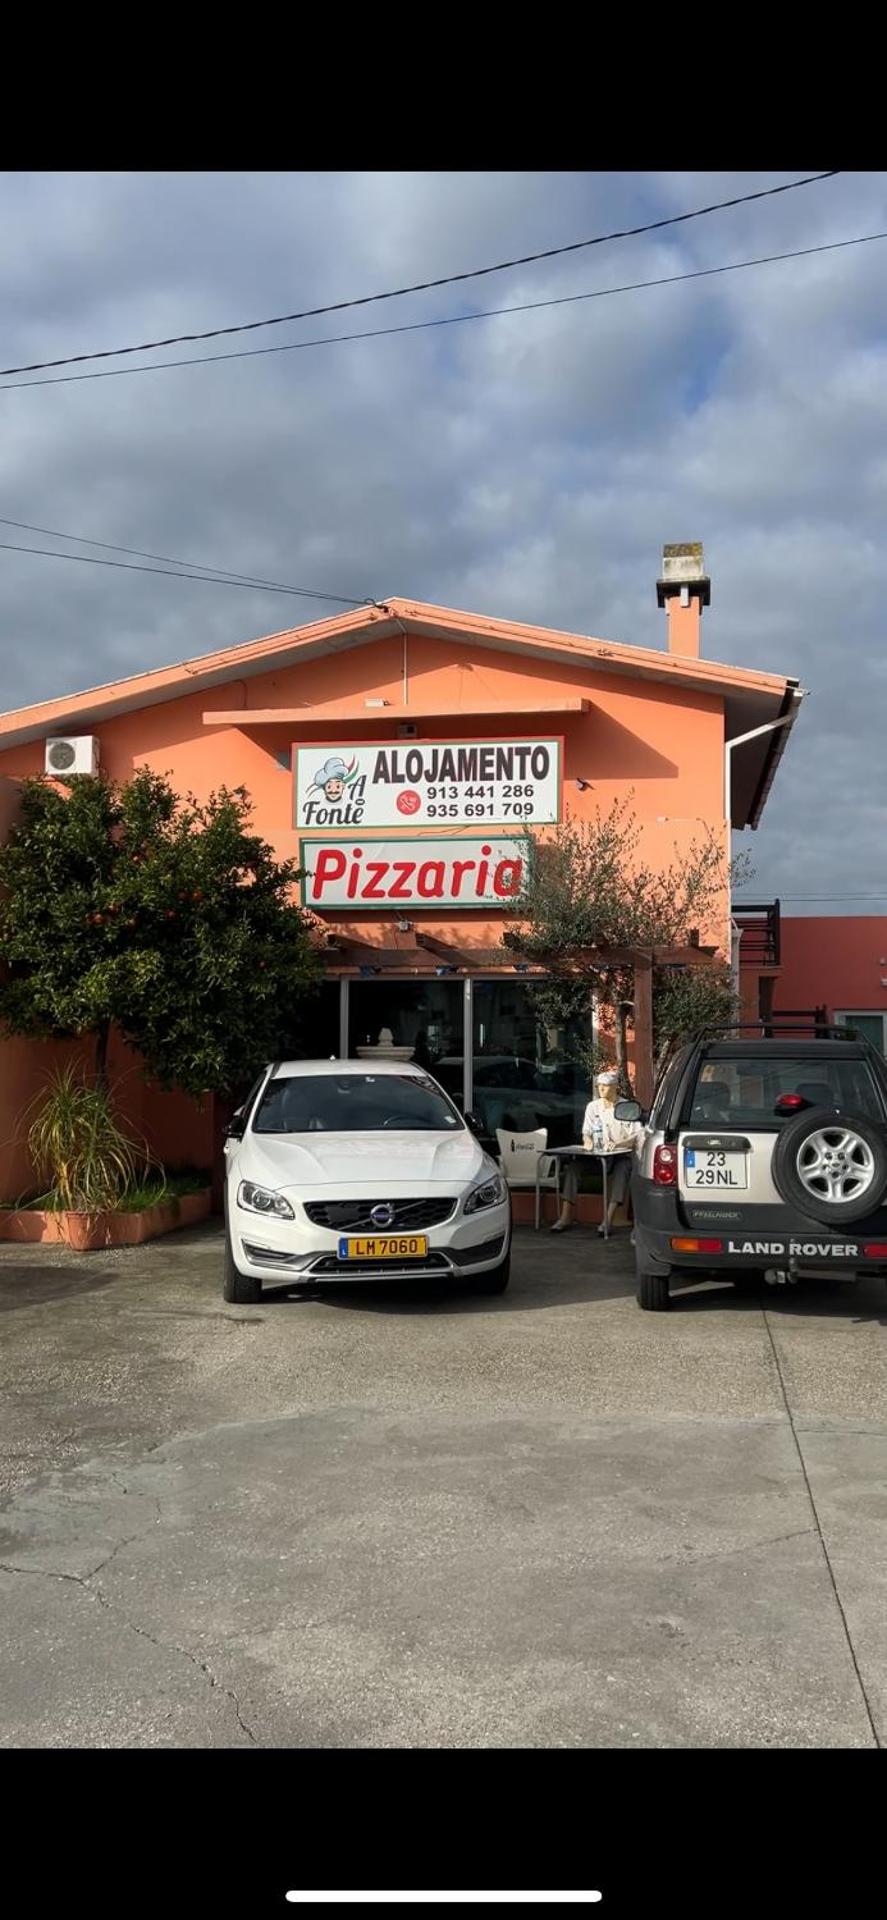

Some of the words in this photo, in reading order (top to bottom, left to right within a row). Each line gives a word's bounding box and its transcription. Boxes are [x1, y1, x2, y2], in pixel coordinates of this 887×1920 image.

[372, 745, 550, 784] ALOJAMENTO
[426, 786, 458, 799] 913
[464, 785, 495, 798] 441
[502, 784, 534, 798] 286
[426, 804, 458, 817] 935
[464, 803, 494, 816] 691
[502, 802, 534, 815] 709
[312, 844, 523, 900] Pizzaria
[707, 1151, 726, 1167] 23
[728, 1241, 785, 1255] LAND
[789, 1243, 858, 1257] ROVER
